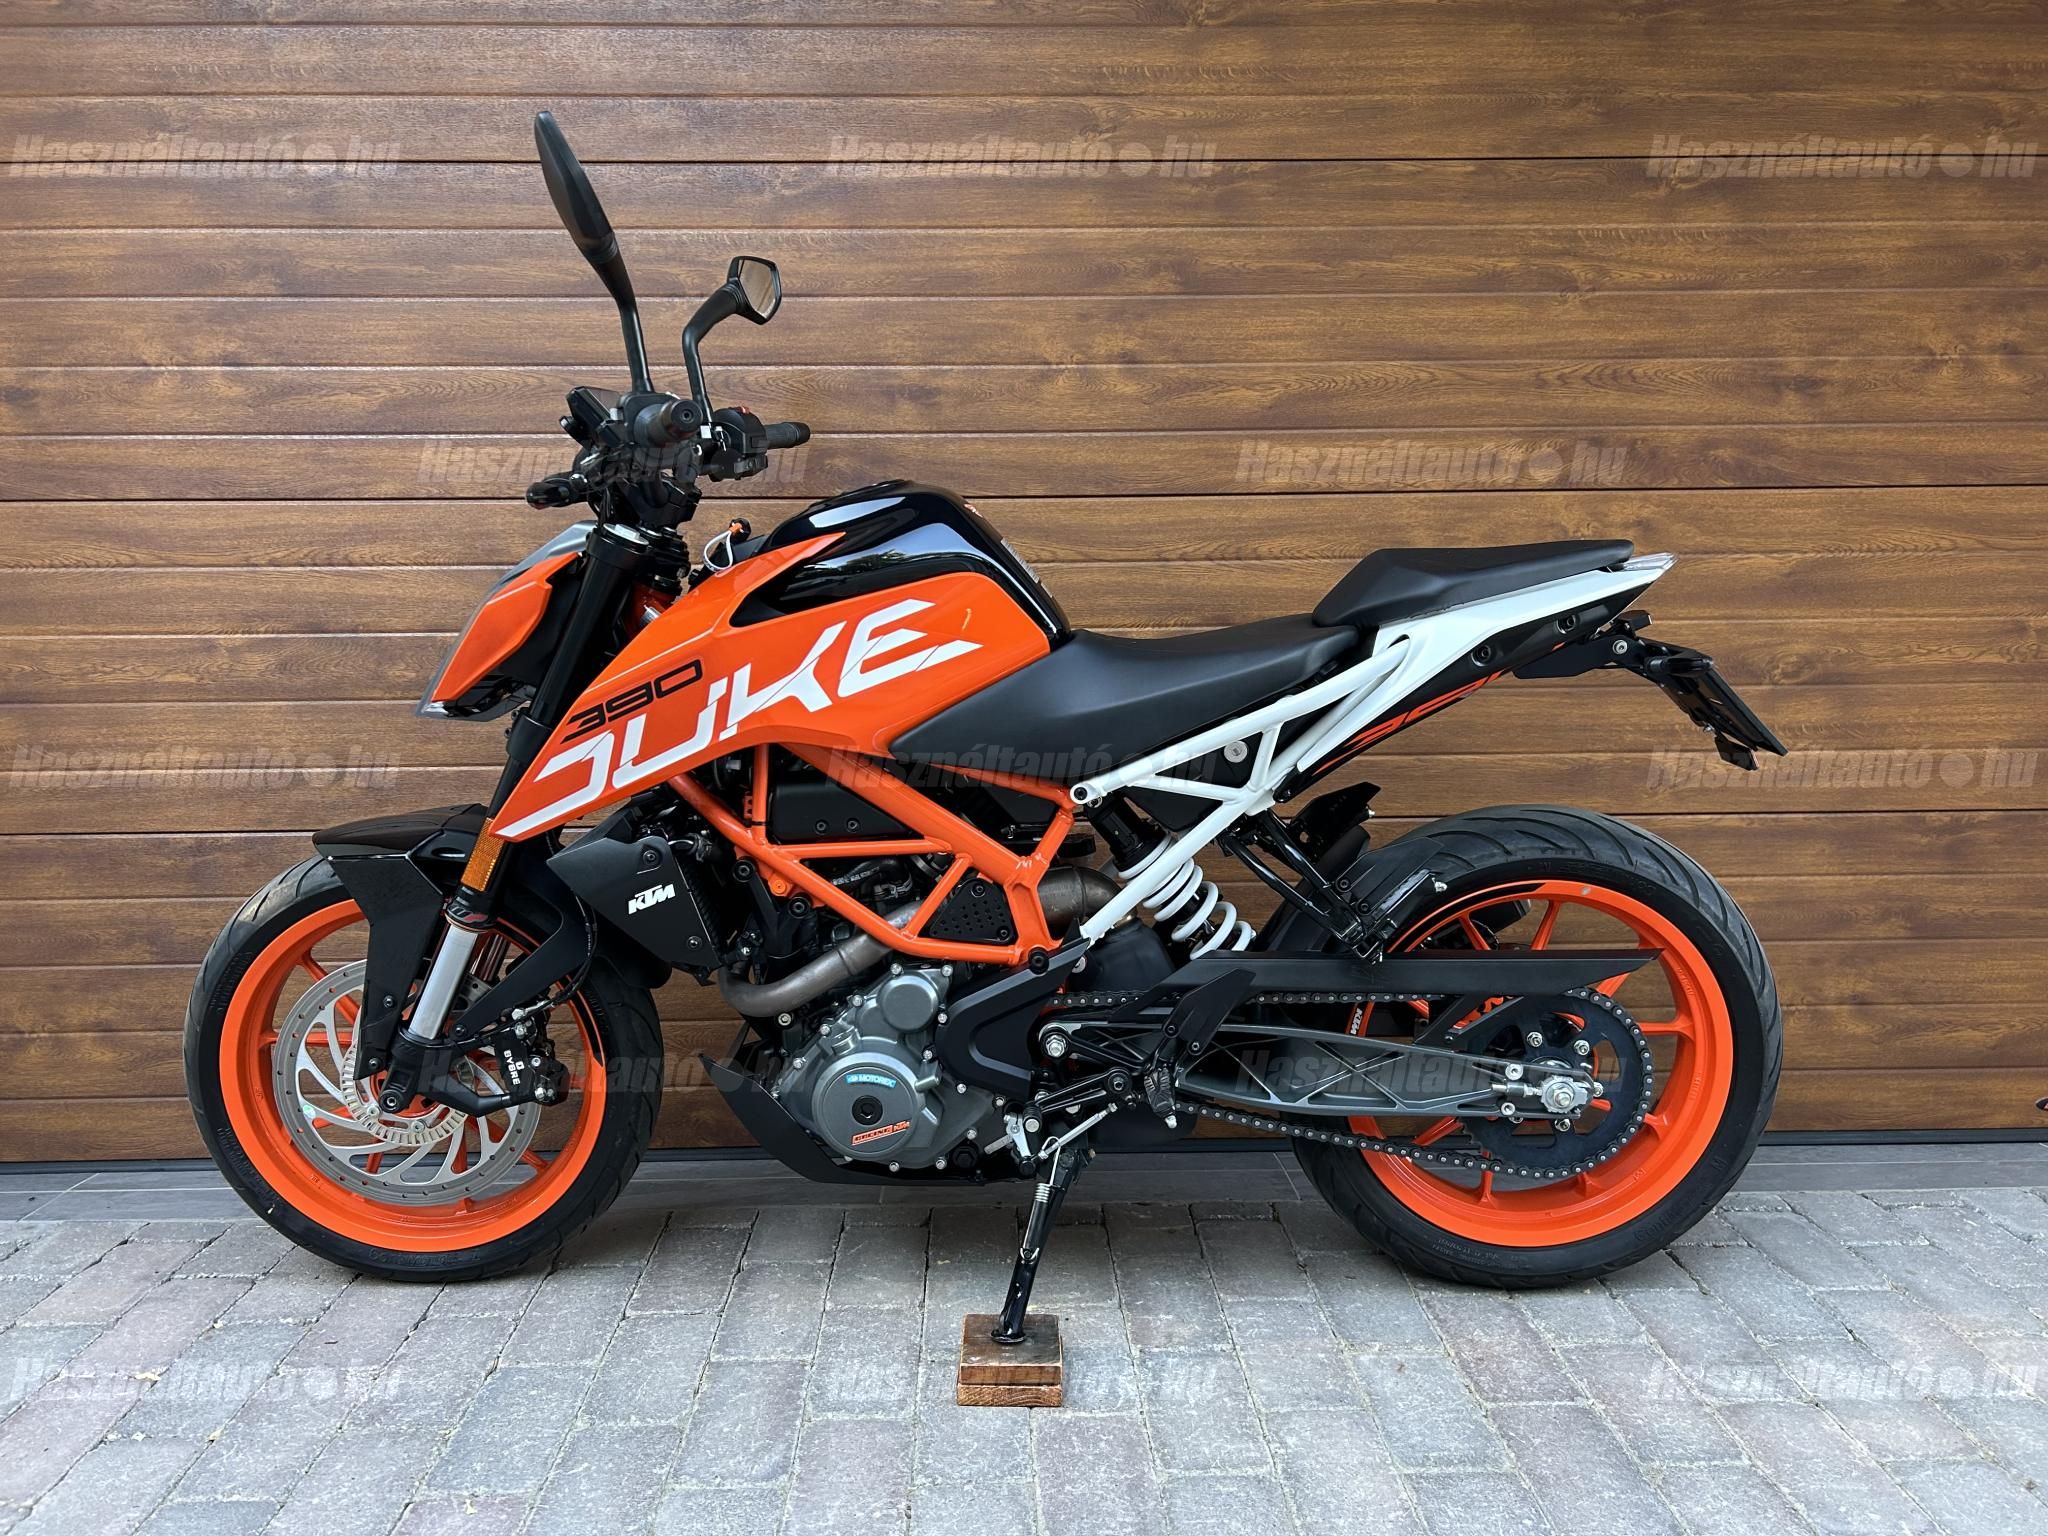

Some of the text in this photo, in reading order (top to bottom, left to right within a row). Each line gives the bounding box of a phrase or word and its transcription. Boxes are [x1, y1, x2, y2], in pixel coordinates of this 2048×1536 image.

[495, 598, 984, 837] DUKE
[561, 657, 704, 744] 390
[628, 883, 676, 915] KTM
[1350, 1007, 1363, 1035] KTM
[503, 1049, 521, 1085] BYBRE
[859, 1074, 897, 1088] MOTOREX
